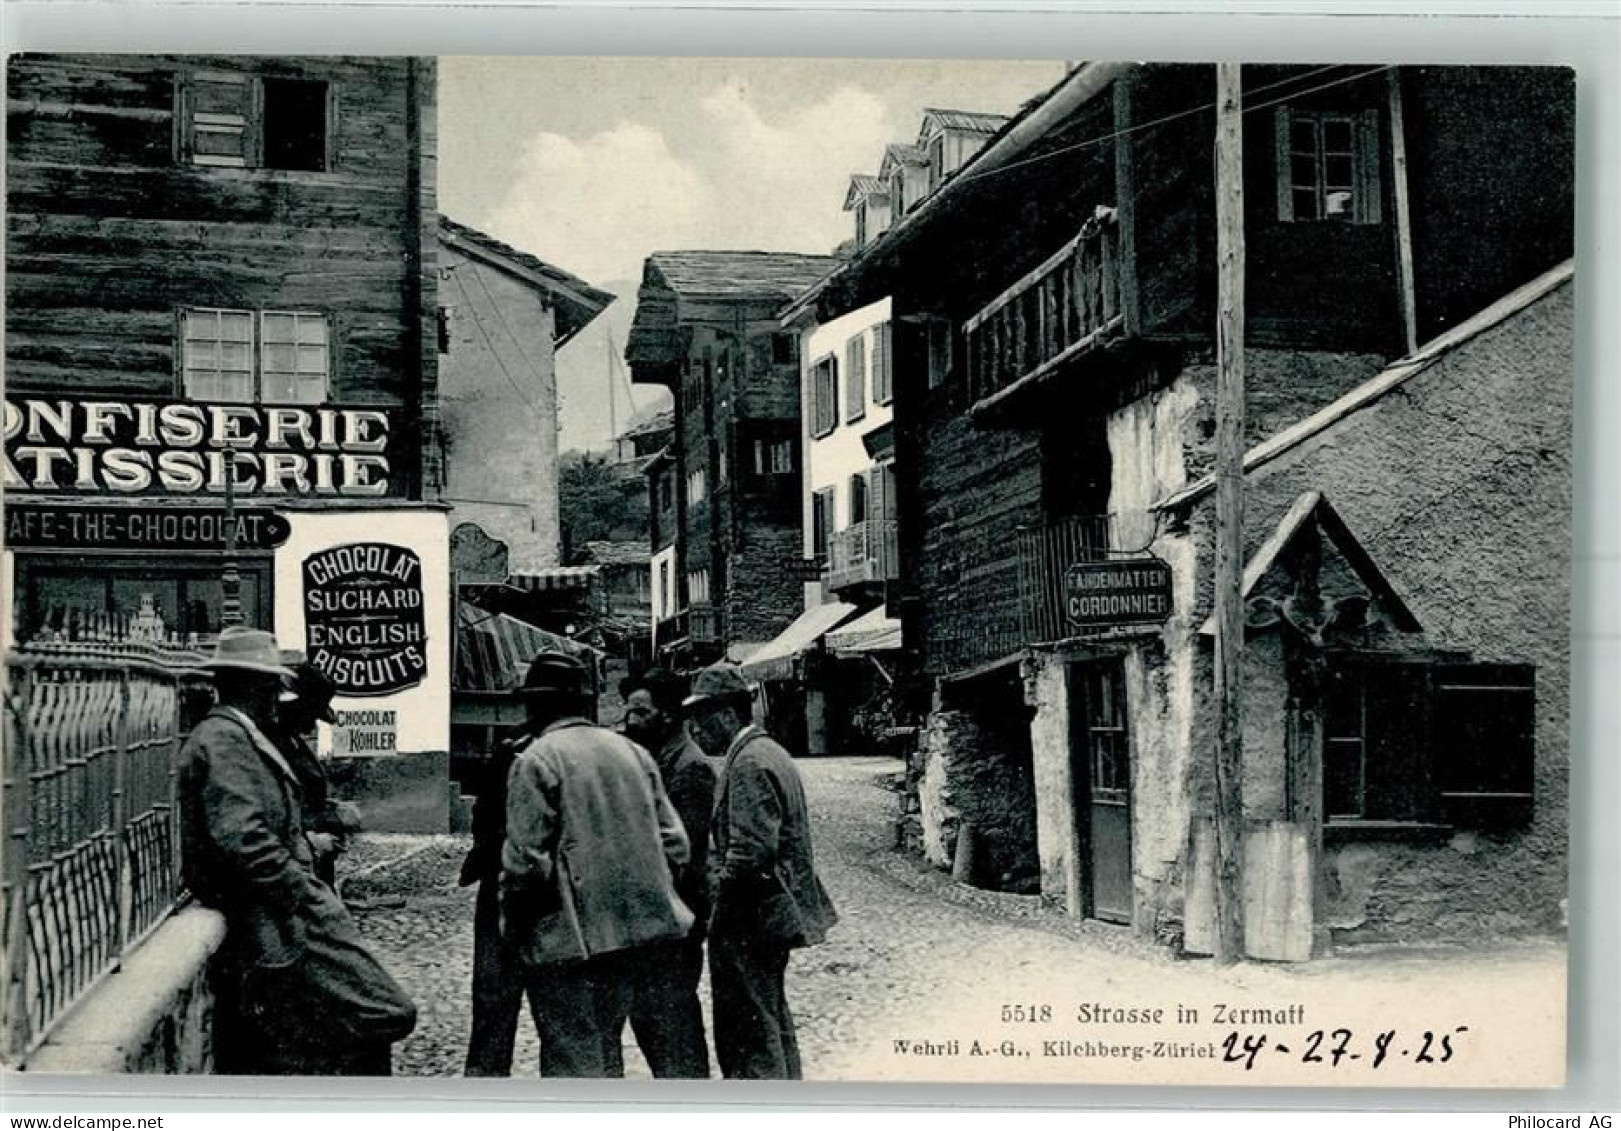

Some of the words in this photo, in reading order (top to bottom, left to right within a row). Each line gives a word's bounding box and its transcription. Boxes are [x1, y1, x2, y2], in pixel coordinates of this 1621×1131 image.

[307, 546, 419, 585] CHOCOLAT
[307, 588, 420, 611] SUCHARD
[1069, 594, 1167, 617] CORDONNIER
[309, 622, 420, 646] ENGLISH
[313, 645, 424, 686] BISCUITS
[336, 710, 397, 727] CHOCOLAT
[348, 728, 397, 753] KOHLER
